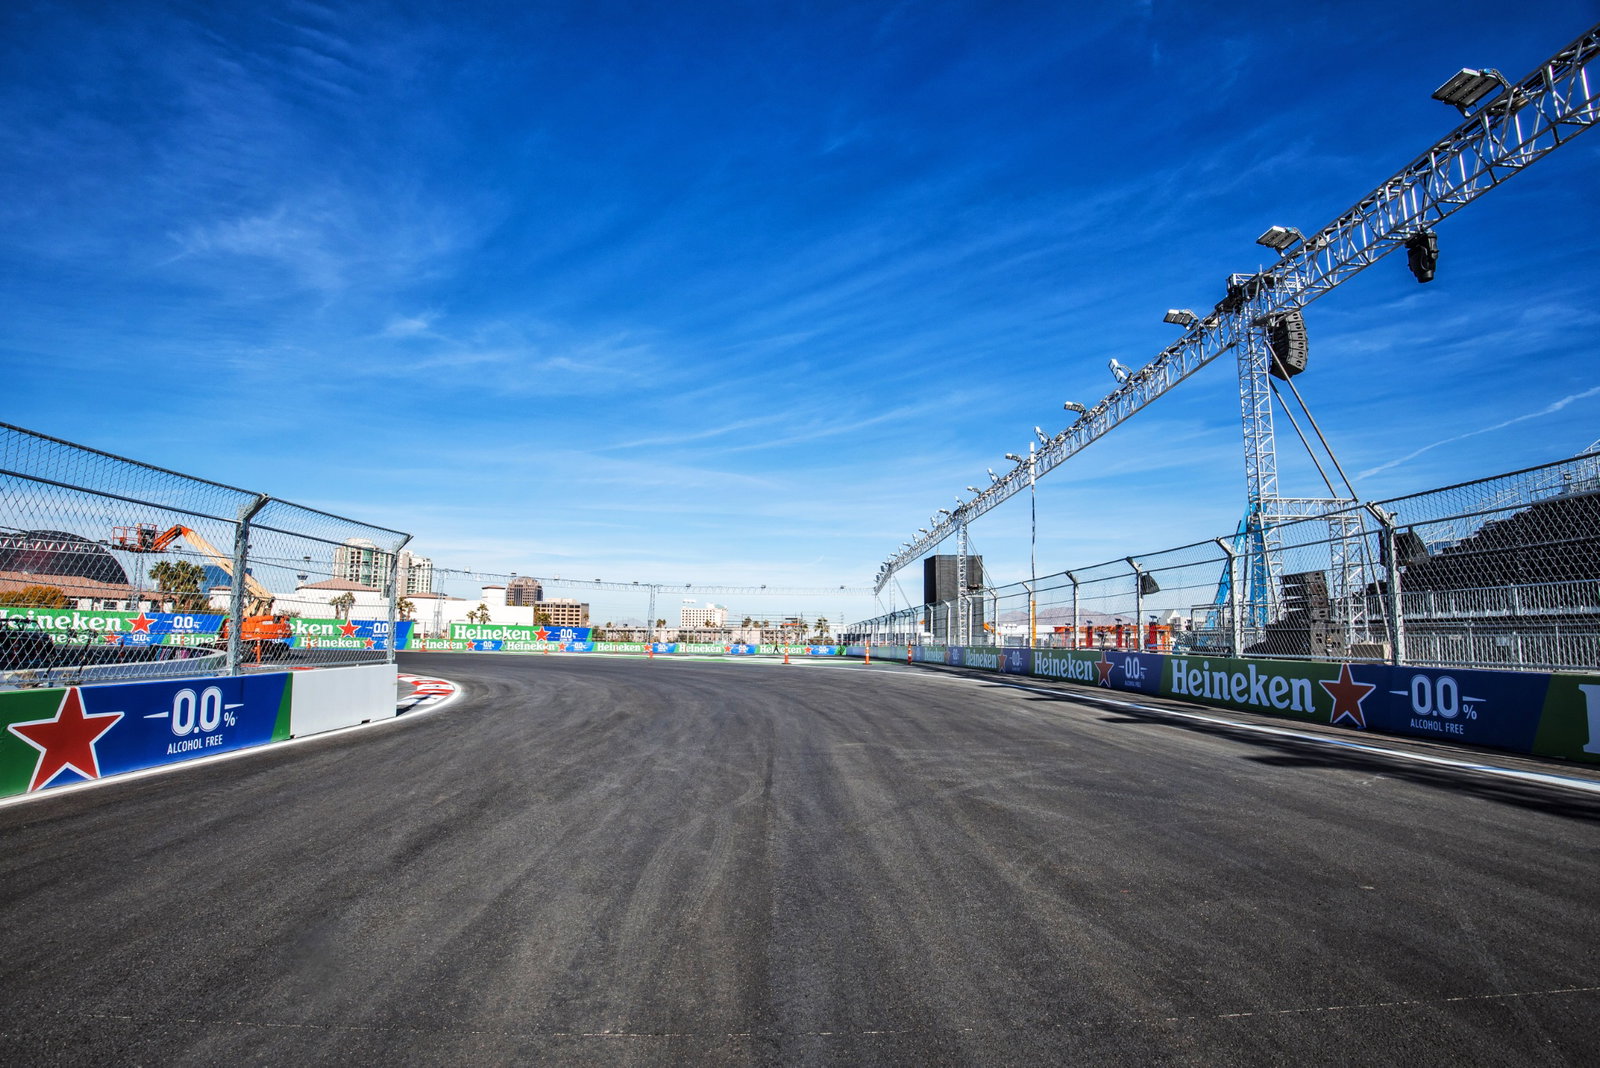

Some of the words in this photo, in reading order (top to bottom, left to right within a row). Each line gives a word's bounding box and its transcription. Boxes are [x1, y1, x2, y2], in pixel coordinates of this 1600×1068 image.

[453, 625, 531, 640] Heineken
[1034, 651, 1094, 681] Heineken
[1170, 659, 1317, 713] Heineken
[1411, 673, 1478, 720] 0.0%
[171, 685, 236, 736] 0.0%
[1410, 718, 1444, 732] ALCOHOL
[1445, 722, 1465, 735] FREE
[166, 738, 203, 756] ALCOHOL
[205, 734, 224, 748] FREE
